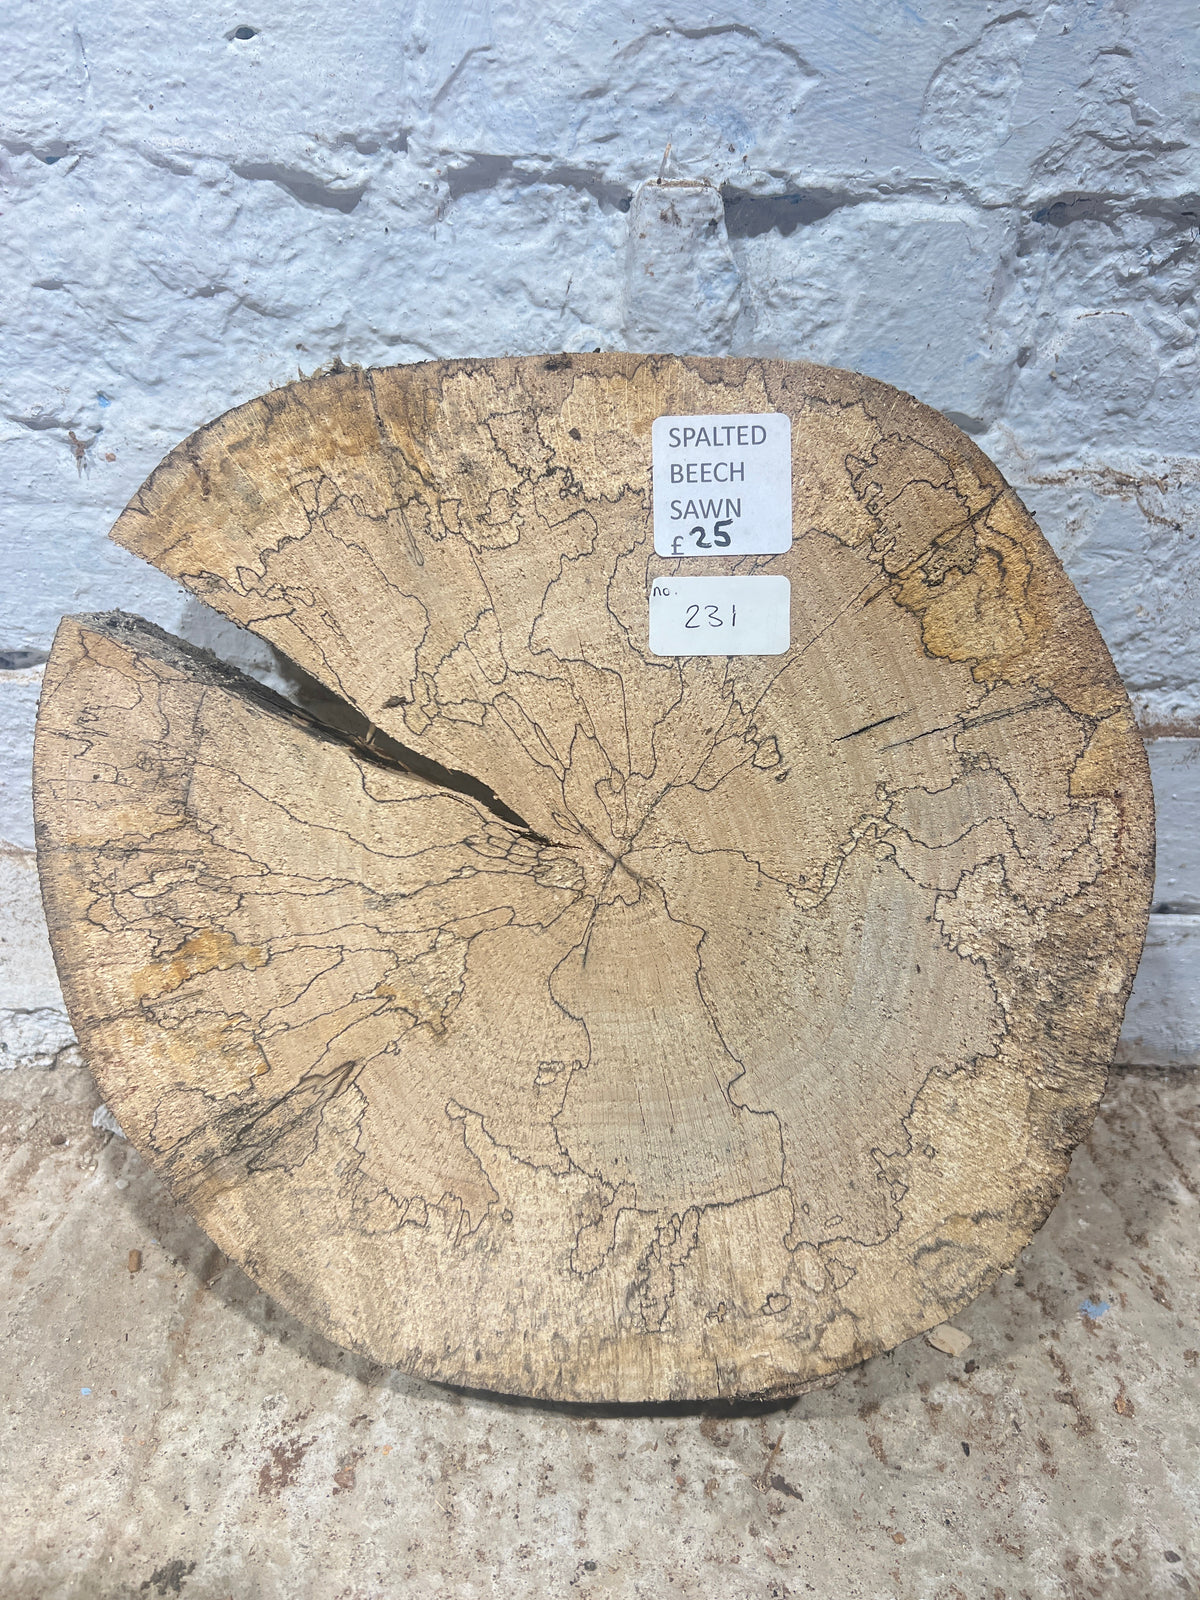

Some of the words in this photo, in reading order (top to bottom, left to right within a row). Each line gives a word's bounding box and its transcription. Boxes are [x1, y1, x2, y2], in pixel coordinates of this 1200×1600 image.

[668, 425, 767, 448] SPALTED
[670, 461, 745, 484] BEECH
[670, 498, 741, 520] SAWN
[685, 604, 737, 629] 231
